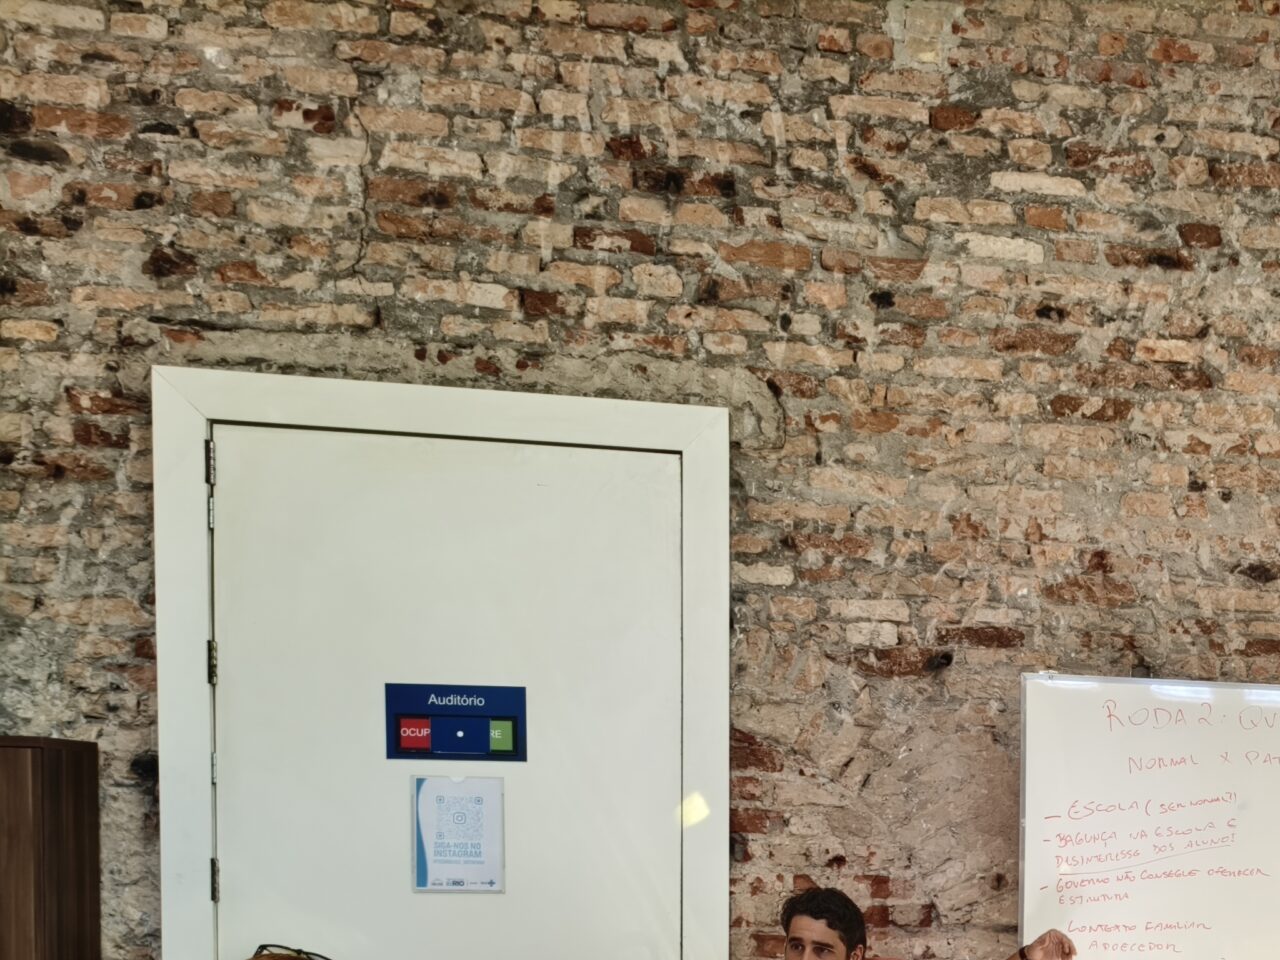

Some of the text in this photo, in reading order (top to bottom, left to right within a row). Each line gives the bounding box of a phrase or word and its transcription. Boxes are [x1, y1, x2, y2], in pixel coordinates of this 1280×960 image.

[427, 693, 485, 706] Auditório
[1102, 699, 1187, 732] RODA
[1128, 753, 1200, 775] NORMAL
[433, 849, 482, 858] INSTAGRAM
